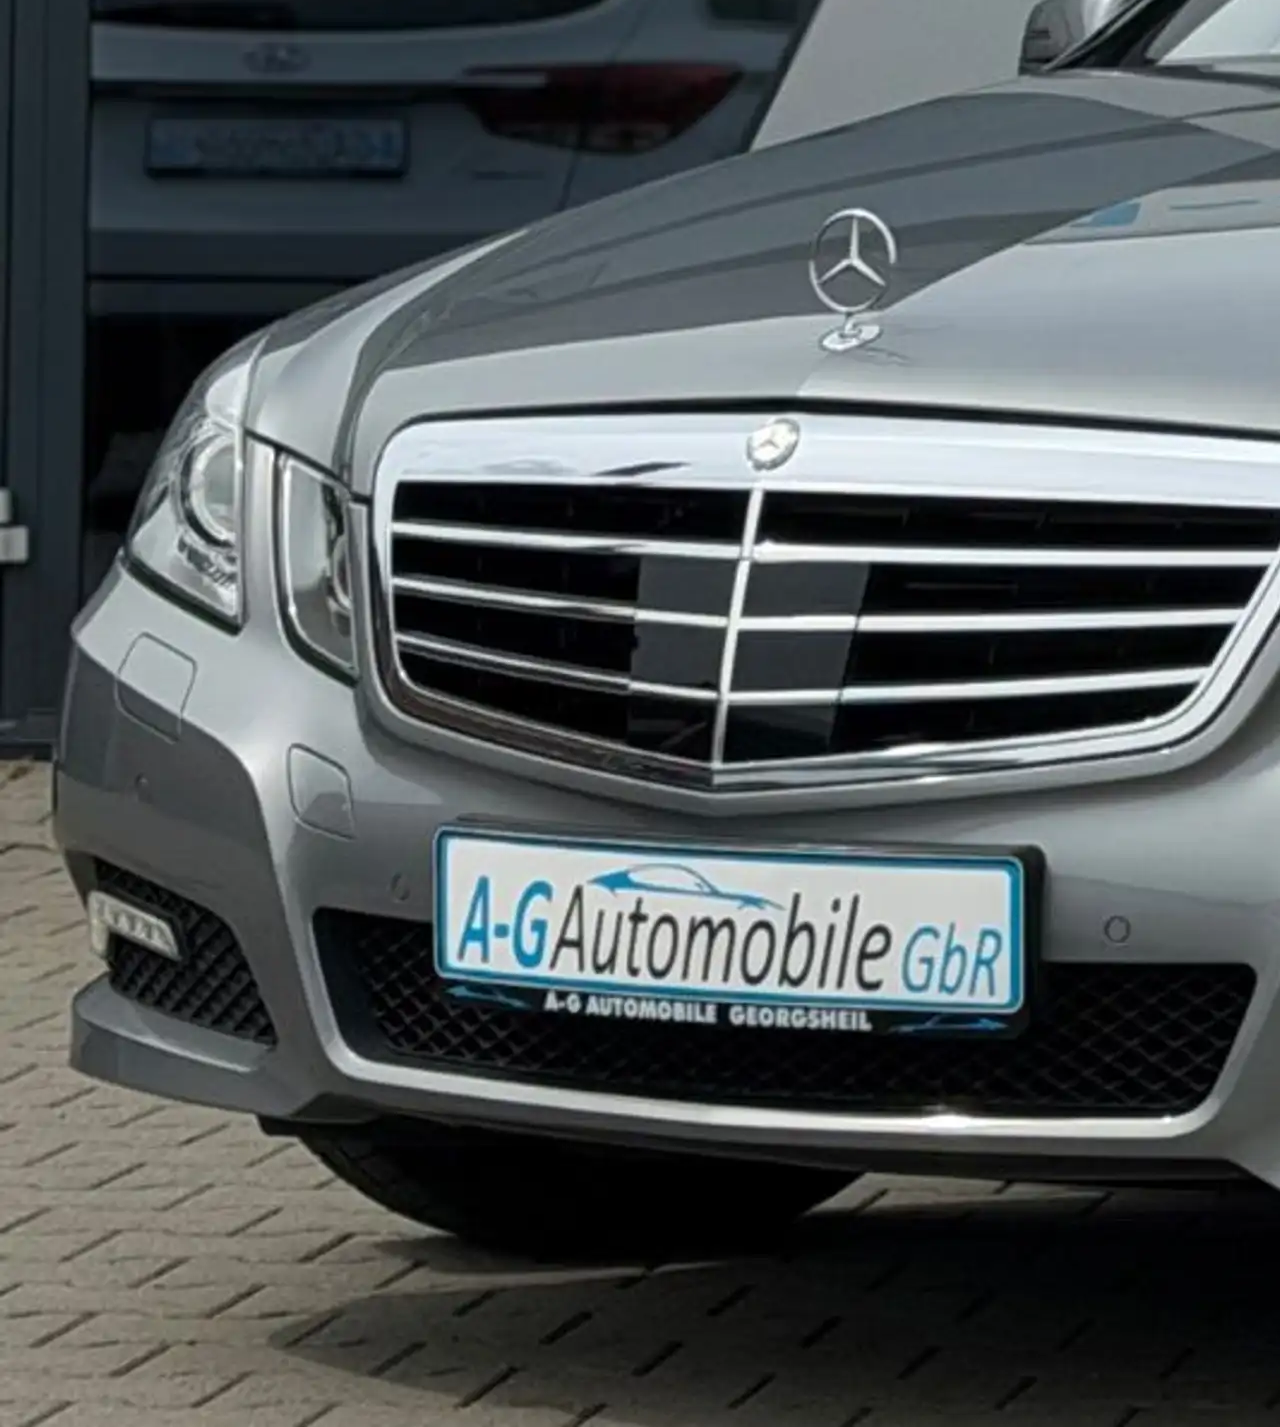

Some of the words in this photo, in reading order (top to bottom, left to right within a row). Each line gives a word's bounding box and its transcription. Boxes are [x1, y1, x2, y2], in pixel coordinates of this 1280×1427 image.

[902, 923, 1003, 997] GbR
[543, 989, 582, 1014] A-G
[585, 995, 718, 1025] AUTOMOBILE
[728, 1006, 873, 1033] GEORGSHEIL
